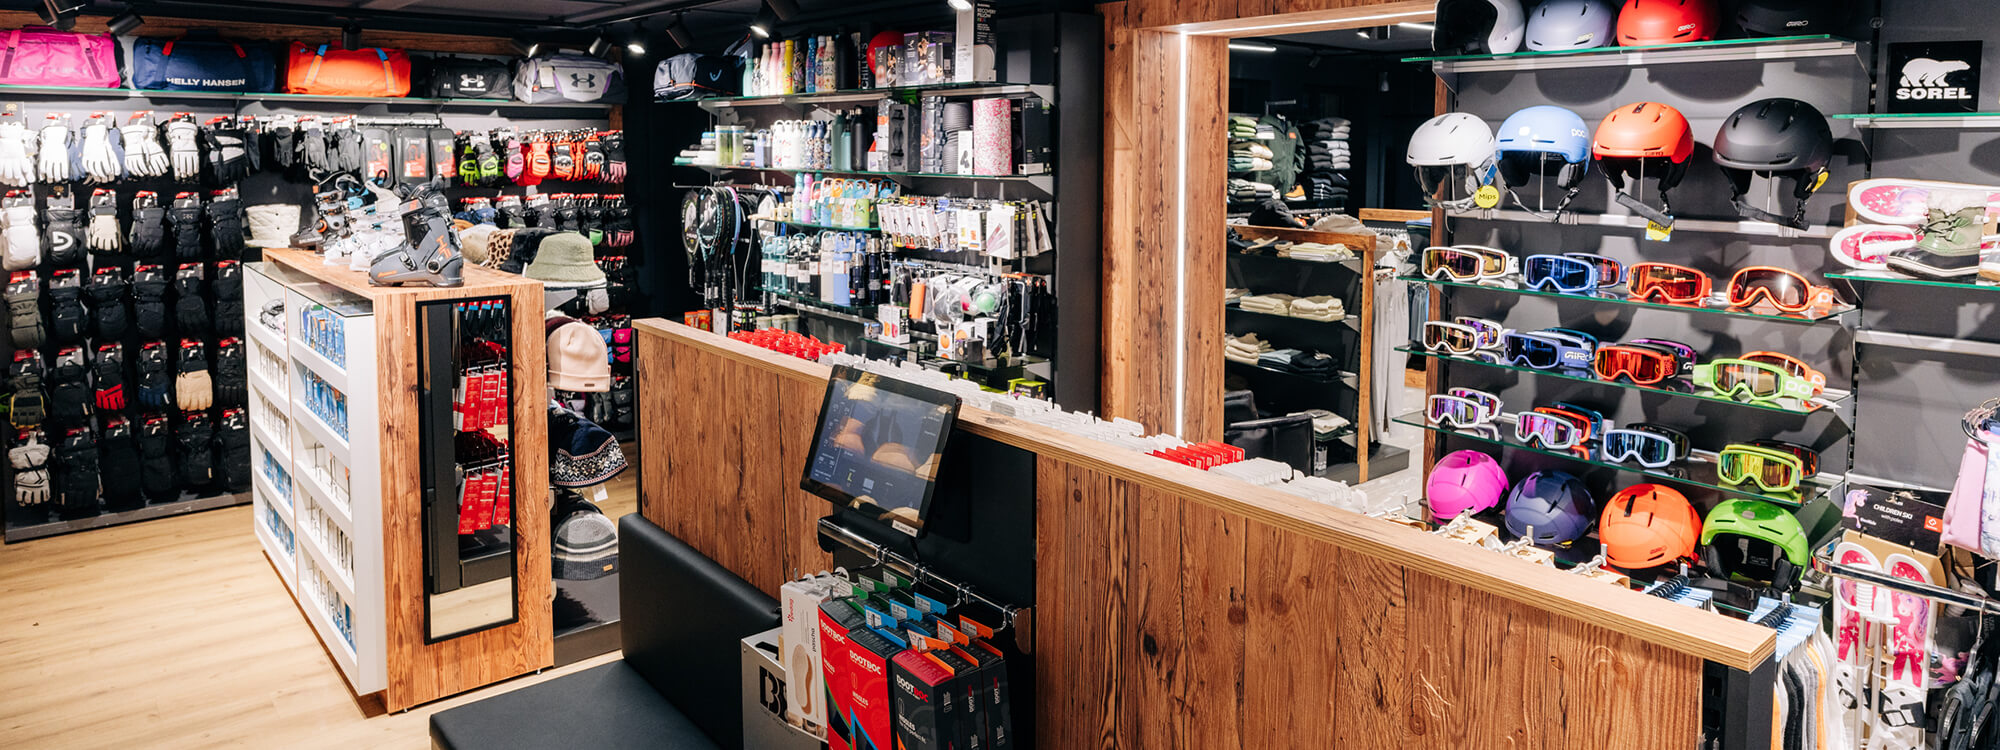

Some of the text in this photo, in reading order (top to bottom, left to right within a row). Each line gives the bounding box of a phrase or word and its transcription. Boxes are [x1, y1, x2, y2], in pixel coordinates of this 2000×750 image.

[166, 77, 246, 87] HELLY HANSEN
[1895, 87, 1972, 100] SOREL
[1478, 193, 1497, 201] Mips
[1785, 380, 1814, 396] PO
[1873, 503, 1901, 517] CHILDREN
[1902, 511, 1914, 520] SKI
